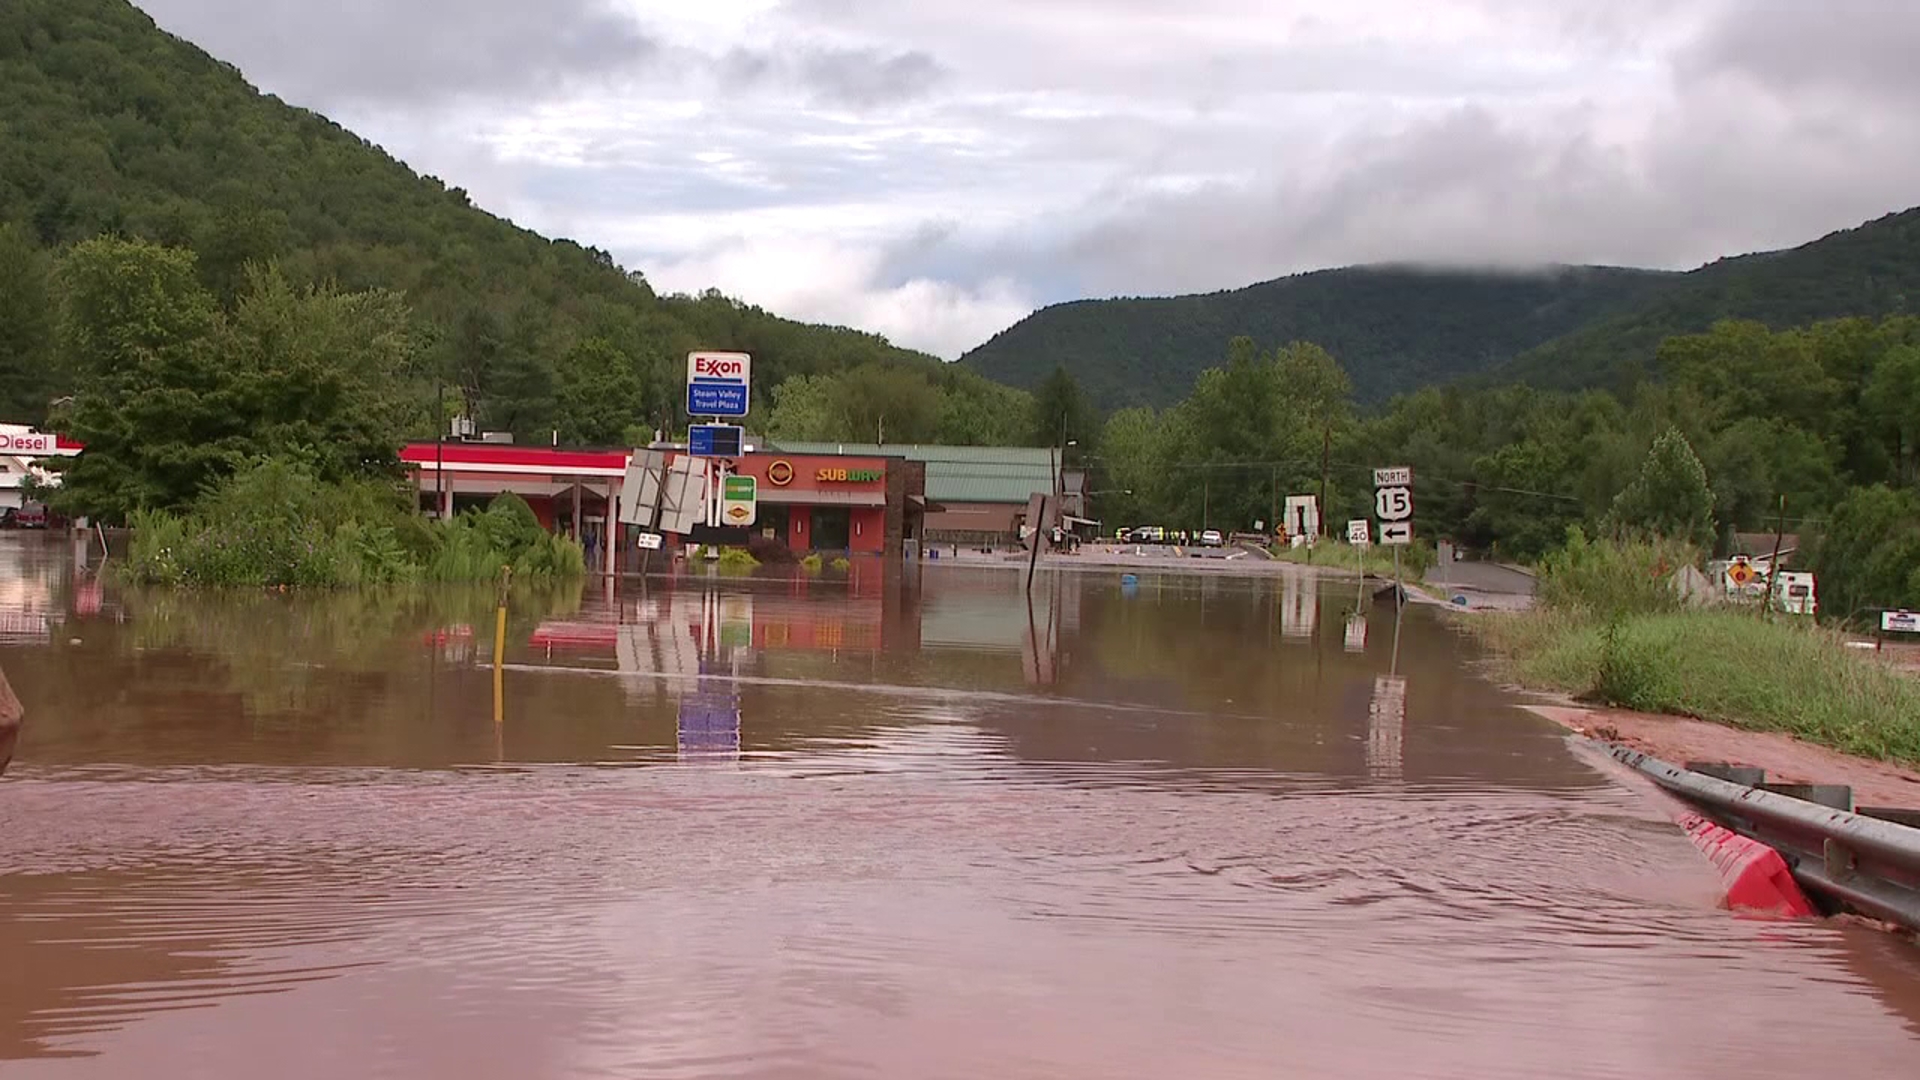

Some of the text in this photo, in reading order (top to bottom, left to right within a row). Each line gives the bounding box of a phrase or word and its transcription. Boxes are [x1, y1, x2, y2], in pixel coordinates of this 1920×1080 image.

[695, 358, 741, 377] Exxon
[693, 389, 717, 398] Steam
[695, 400, 739, 409] Travel Plaza
[0, 434, 47, 450] Diesel
[816, 468, 883, 481] SUBWAY
[1376, 471, 1408, 483] NORTH
[1382, 493, 1406, 513] 15
[1351, 532, 1367, 541] 40
